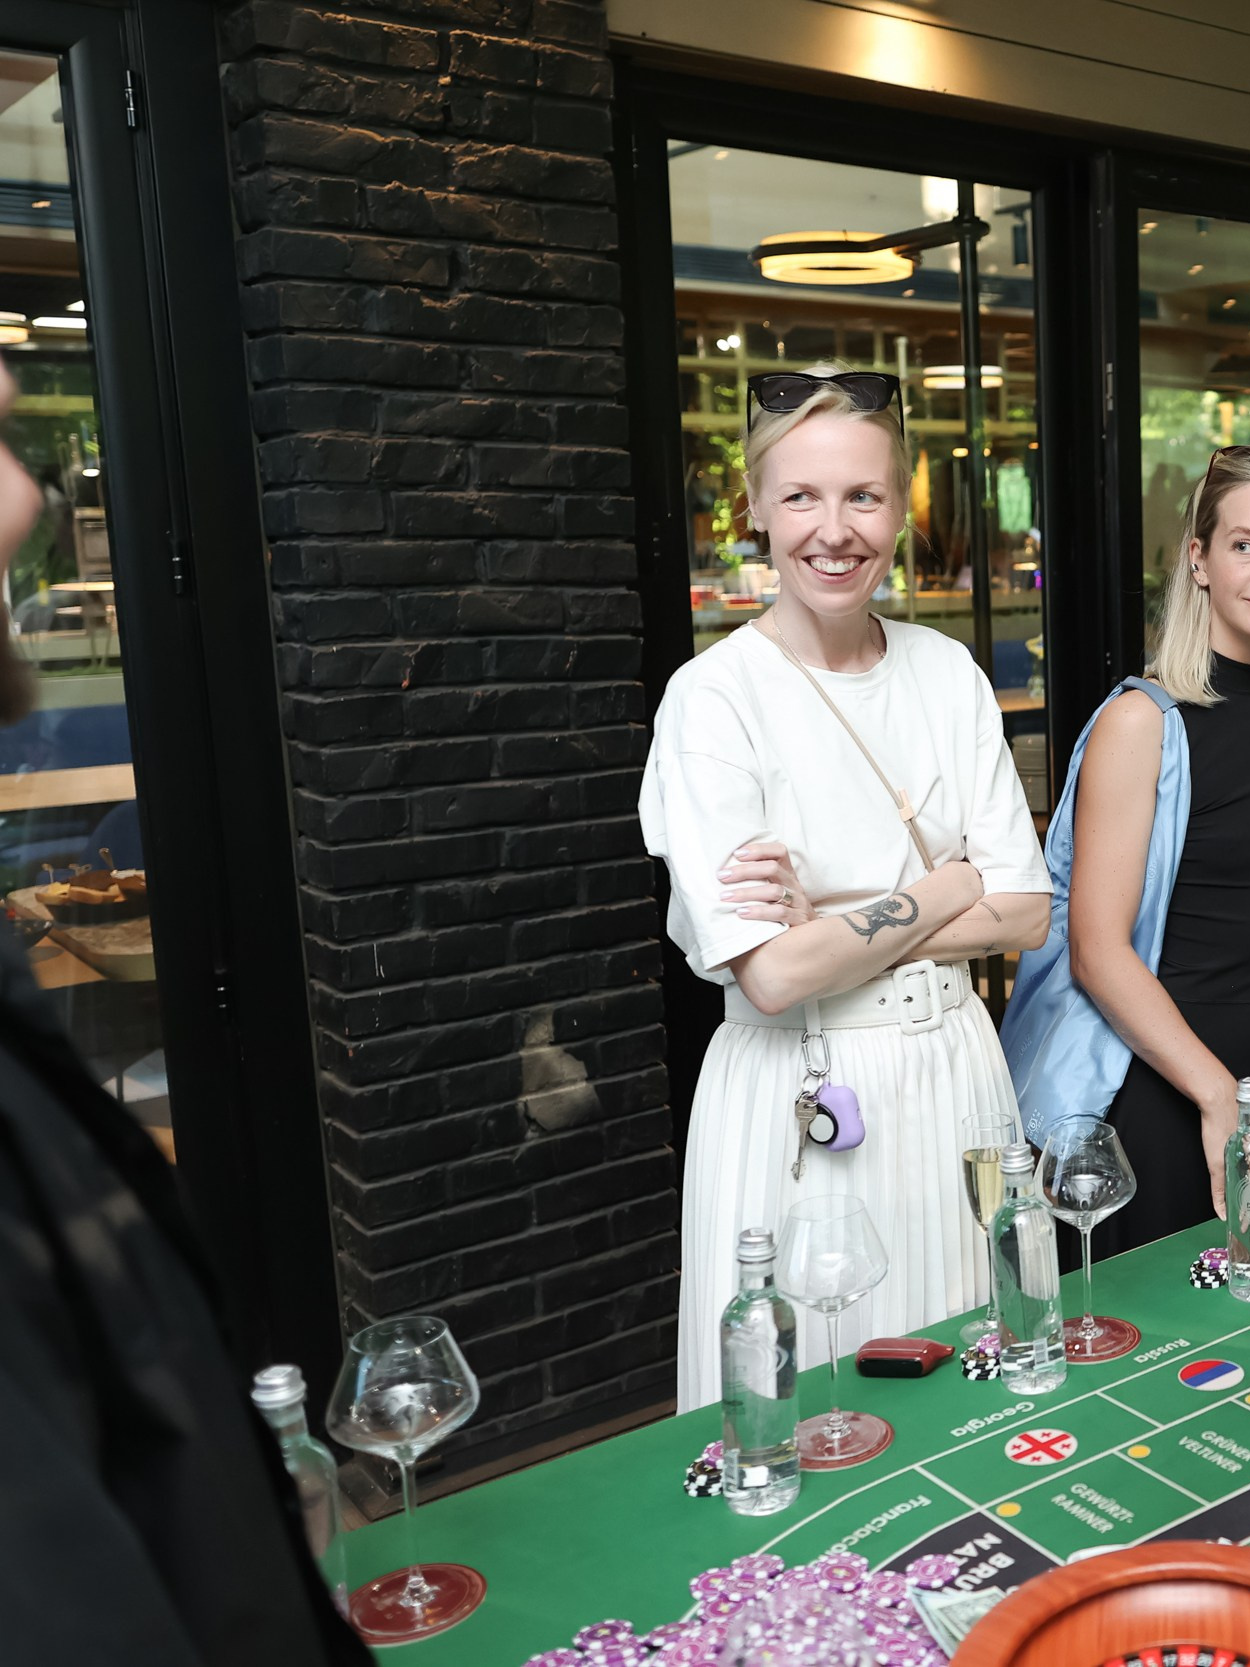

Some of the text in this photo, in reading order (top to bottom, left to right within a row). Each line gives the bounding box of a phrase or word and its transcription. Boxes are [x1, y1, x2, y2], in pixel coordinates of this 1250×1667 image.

[1133, 1338, 1191, 1364] Russia
[950, 1400, 1036, 1437] Georgia
[1177, 1436, 1243, 1474] VELTLINER
[1050, 1494, 1115, 1534] RAMINER
[1070, 1482, 1135, 1524] GEWÜRZT-
[813, 1494, 932, 1560] Franciaco
